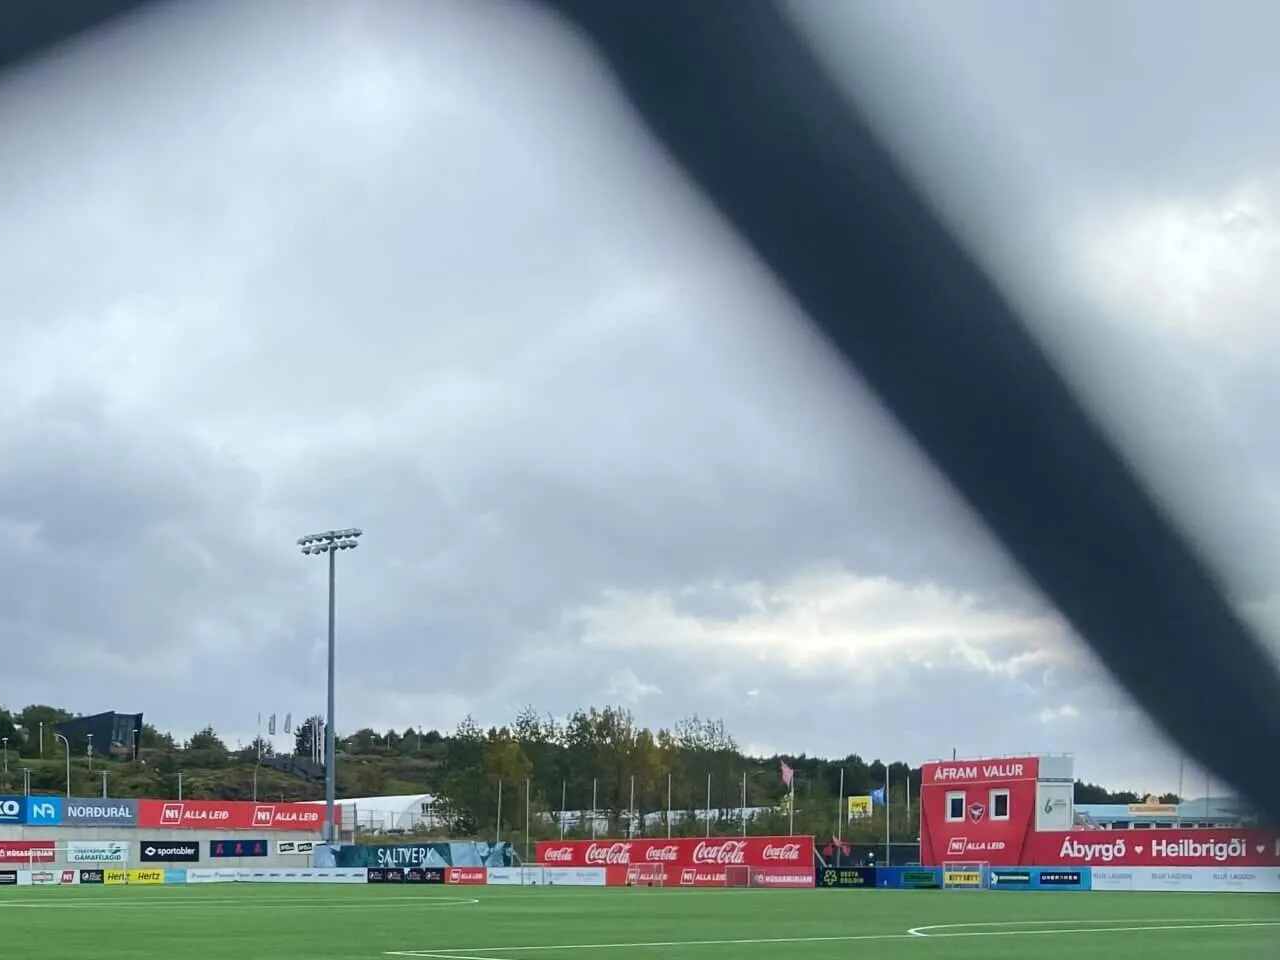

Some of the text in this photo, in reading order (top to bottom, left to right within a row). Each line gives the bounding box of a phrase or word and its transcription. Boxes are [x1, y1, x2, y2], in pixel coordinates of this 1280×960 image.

[934, 764, 1024, 781] ÁFRAM VALUR
[68, 804, 133, 817] NORÐURÁL
[184, 810, 207, 819] ALLA
[275, 812, 297, 821] ALLA
[966, 842, 985, 850] ALLA
[1060, 836, 1126, 861] Ábyrgð
[1151, 838, 1247, 861] Heilbrigði
[377, 848, 435, 863] SALTVERK
[137, 872, 161, 880] Hertz
